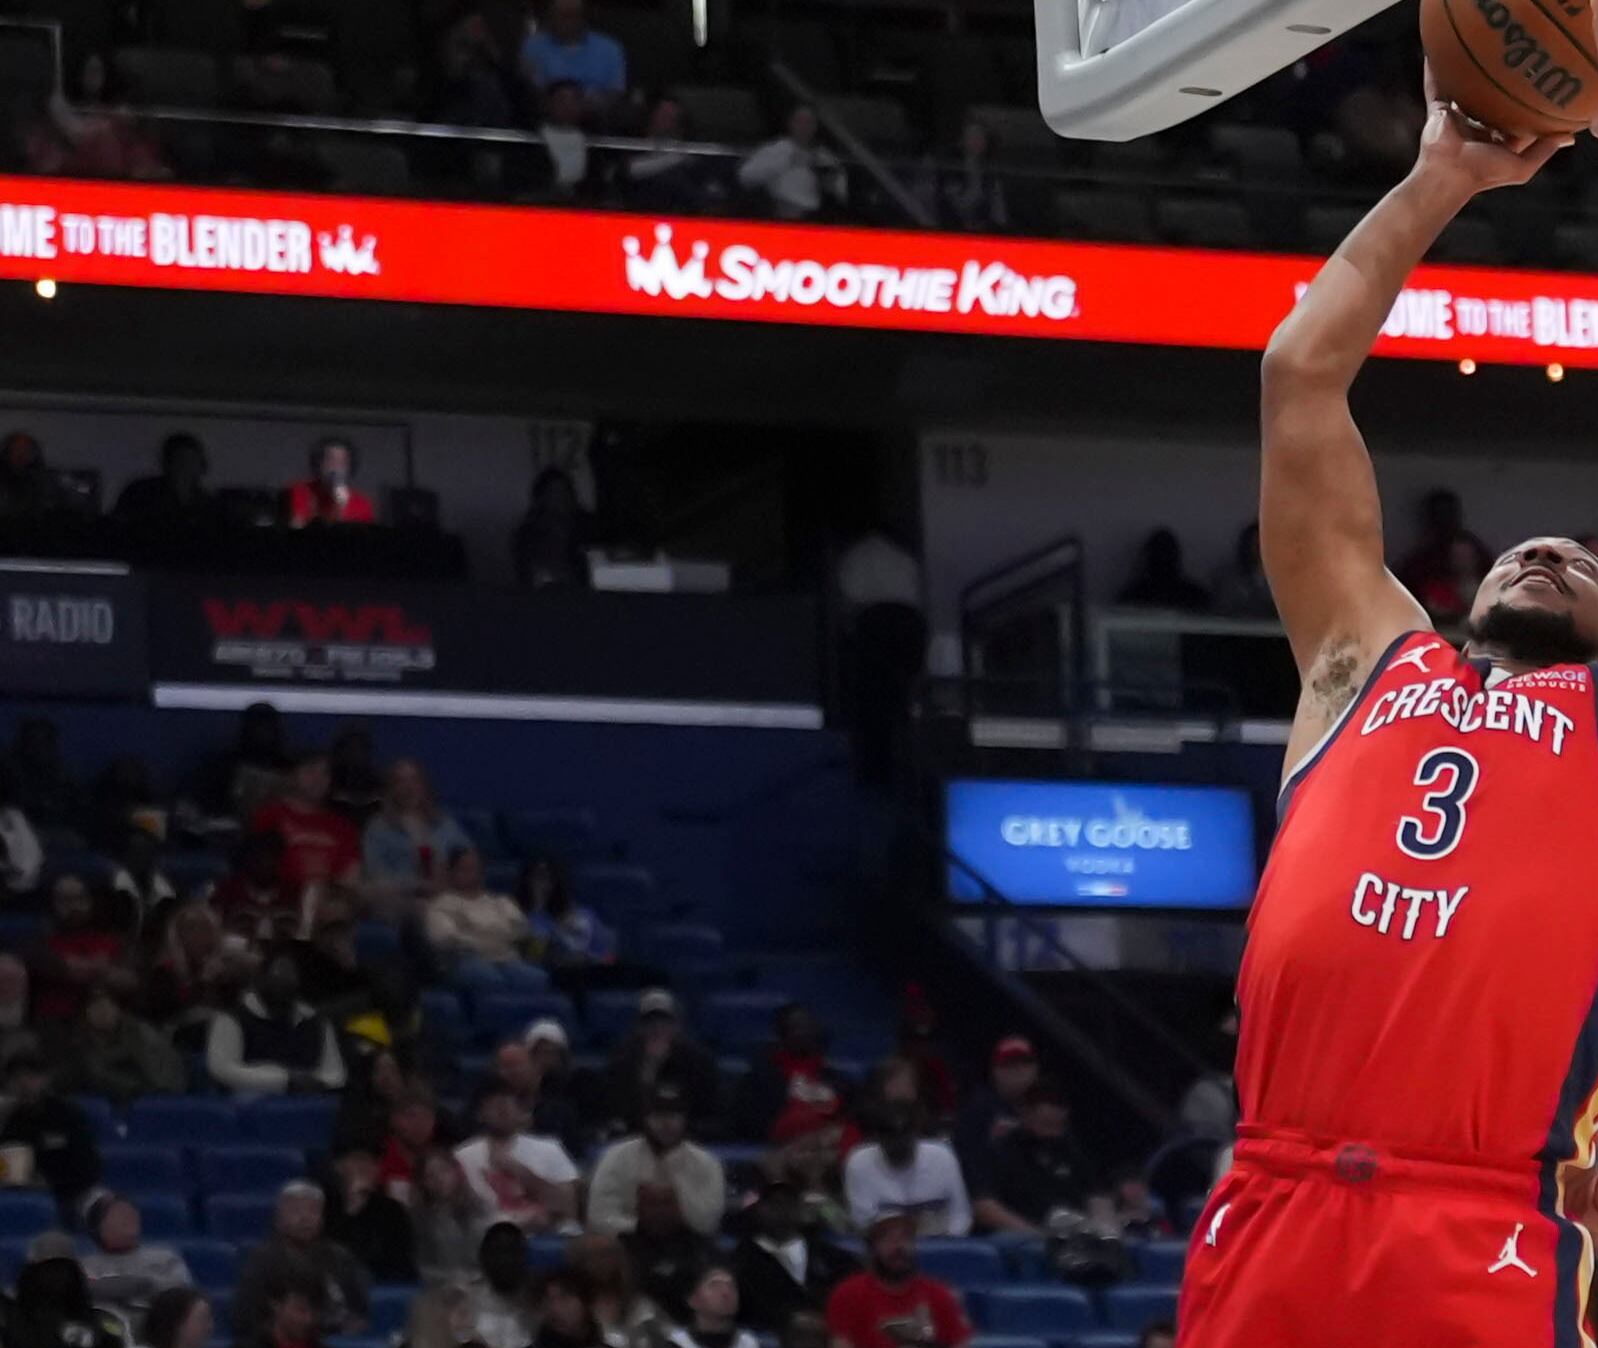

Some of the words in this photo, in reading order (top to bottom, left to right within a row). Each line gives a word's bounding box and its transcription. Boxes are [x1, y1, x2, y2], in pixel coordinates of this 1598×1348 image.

[61, 213, 96, 255] TO
[97, 215, 148, 258] THE
[149, 212, 312, 274] BLENDER
[716, 244, 957, 313] SMOOTHIE
[957, 260, 1076, 320] KING
[1456, 297, 1488, 336] TO
[1488, 299, 1532, 339] THE
[12, 599, 114, 643] RADIO
[1360, 678, 1575, 756] CRESCENT
[1001, 814, 1082, 847] GREY
[1084, 817, 1193, 849] GOOSE
[1395, 746, 1480, 861] 3
[1350, 871, 1469, 940] CITY
